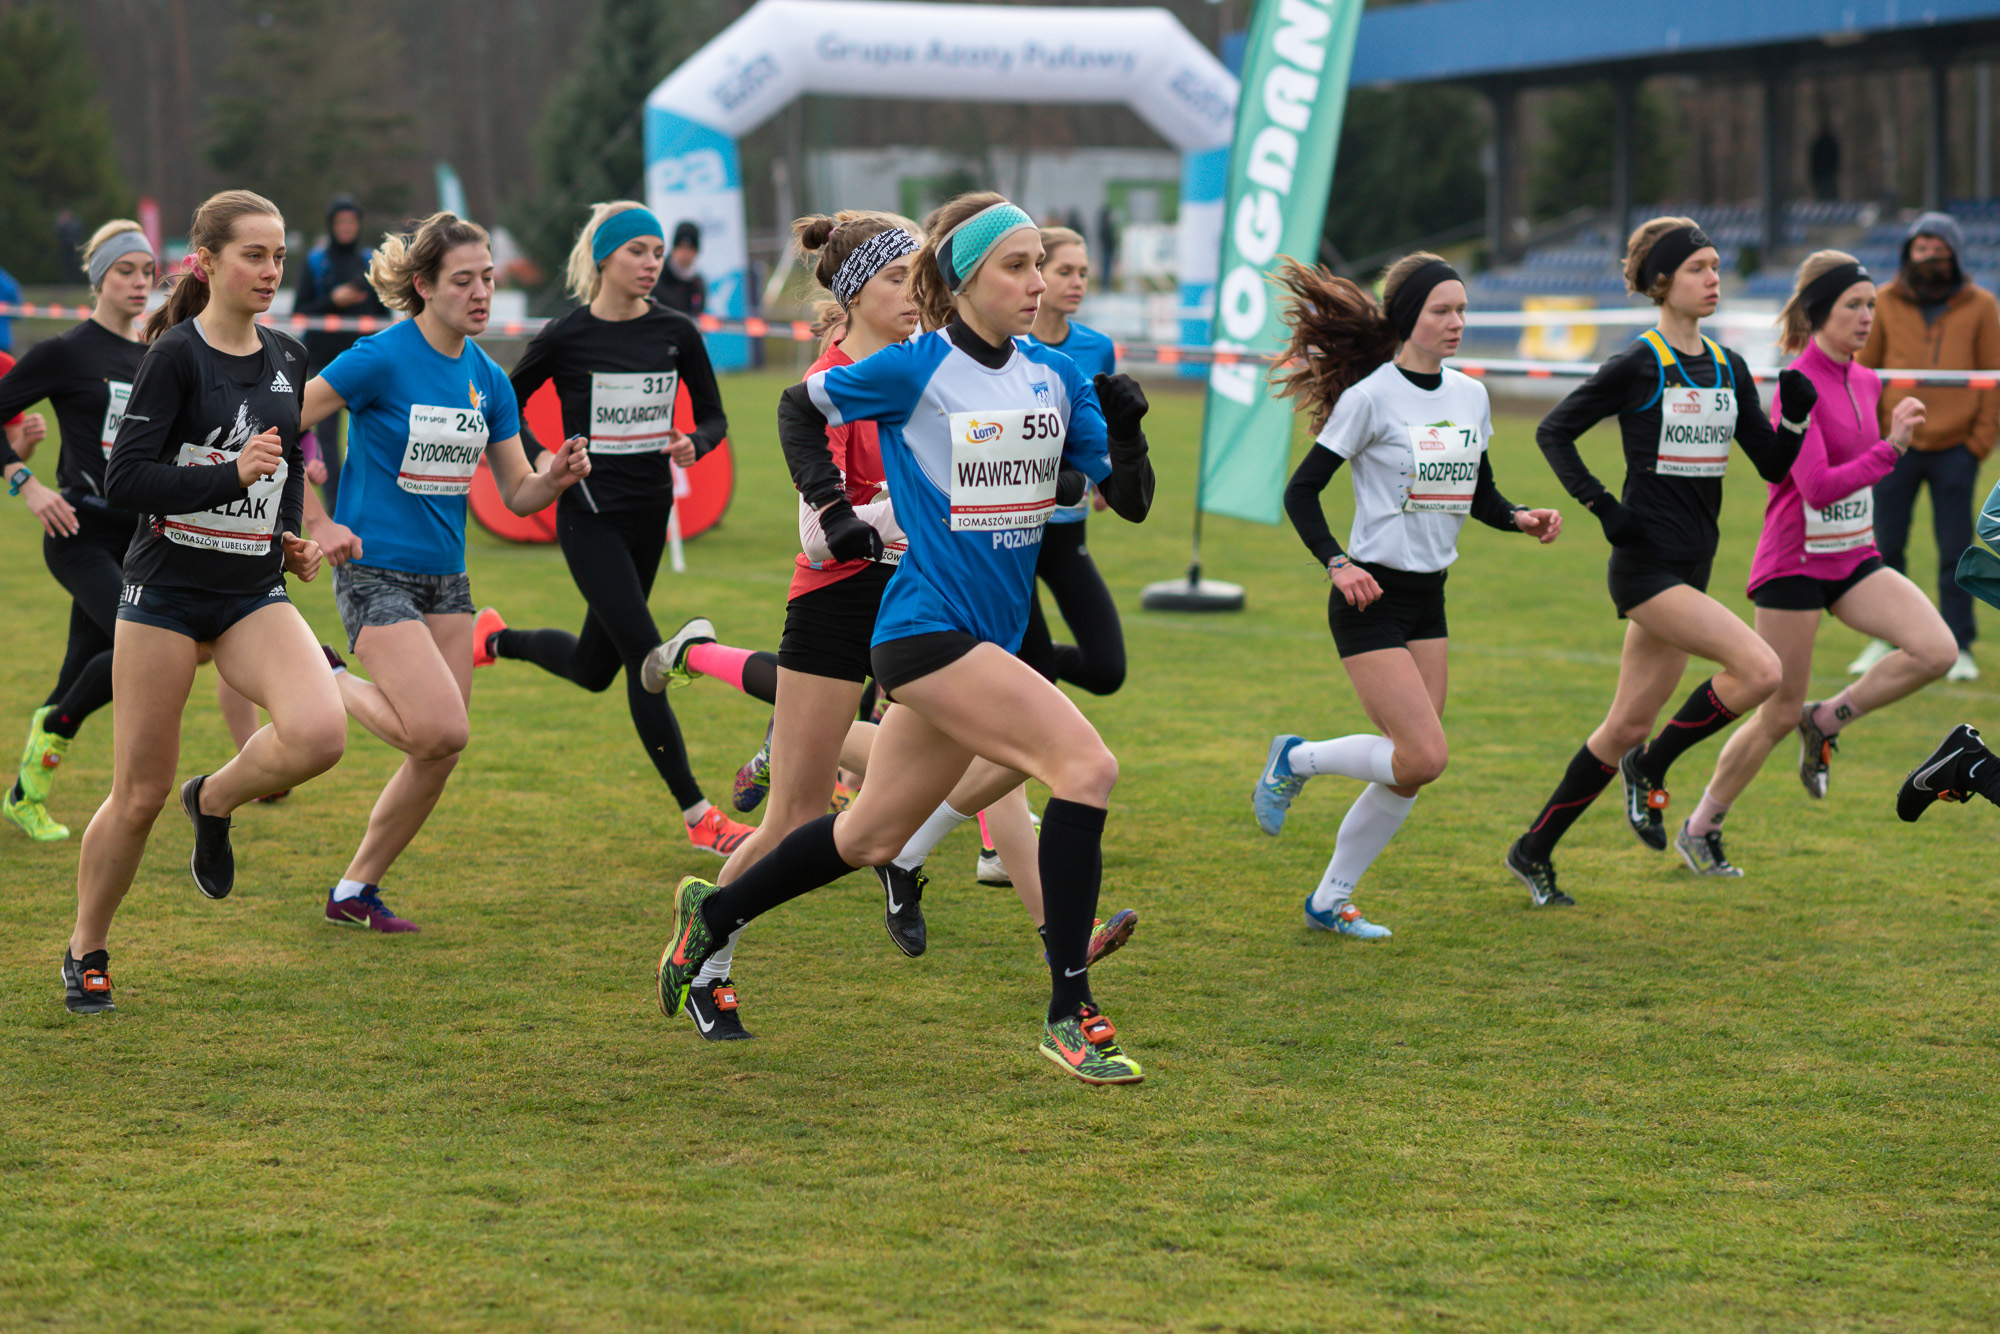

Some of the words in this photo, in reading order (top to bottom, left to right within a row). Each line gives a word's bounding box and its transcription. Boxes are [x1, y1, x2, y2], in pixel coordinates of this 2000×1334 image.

[816, 33, 917, 67] Grupa
[1209, 0, 1334, 407] BOGDAN
[643, 376, 674, 394] 317
[1715, 393, 1730, 411] 59
[429, 416, 447, 424] SPORT
[456, 413, 485, 433] 249
[596, 403, 671, 425] SMOLARCZYK
[973, 425, 997, 440] LOTTO
[1021, 413, 1060, 440] 550
[1459, 429, 1477, 448] 74
[410, 442, 484, 465] SYDORCHUK
[958, 456, 1059, 488] WAWRZYNIAK
[403, 481, 439, 492] TOMASZÓW
[958, 514, 1013, 527] TOMASZÓW
[1014, 513, 1042, 525] LUBELSKI
[1821, 499, 1868, 523] BREZA
[170, 531, 220, 548] TOMASZÓW
[221, 540, 255, 552] LUBELSKI
[254, 543, 267, 552] 2021
